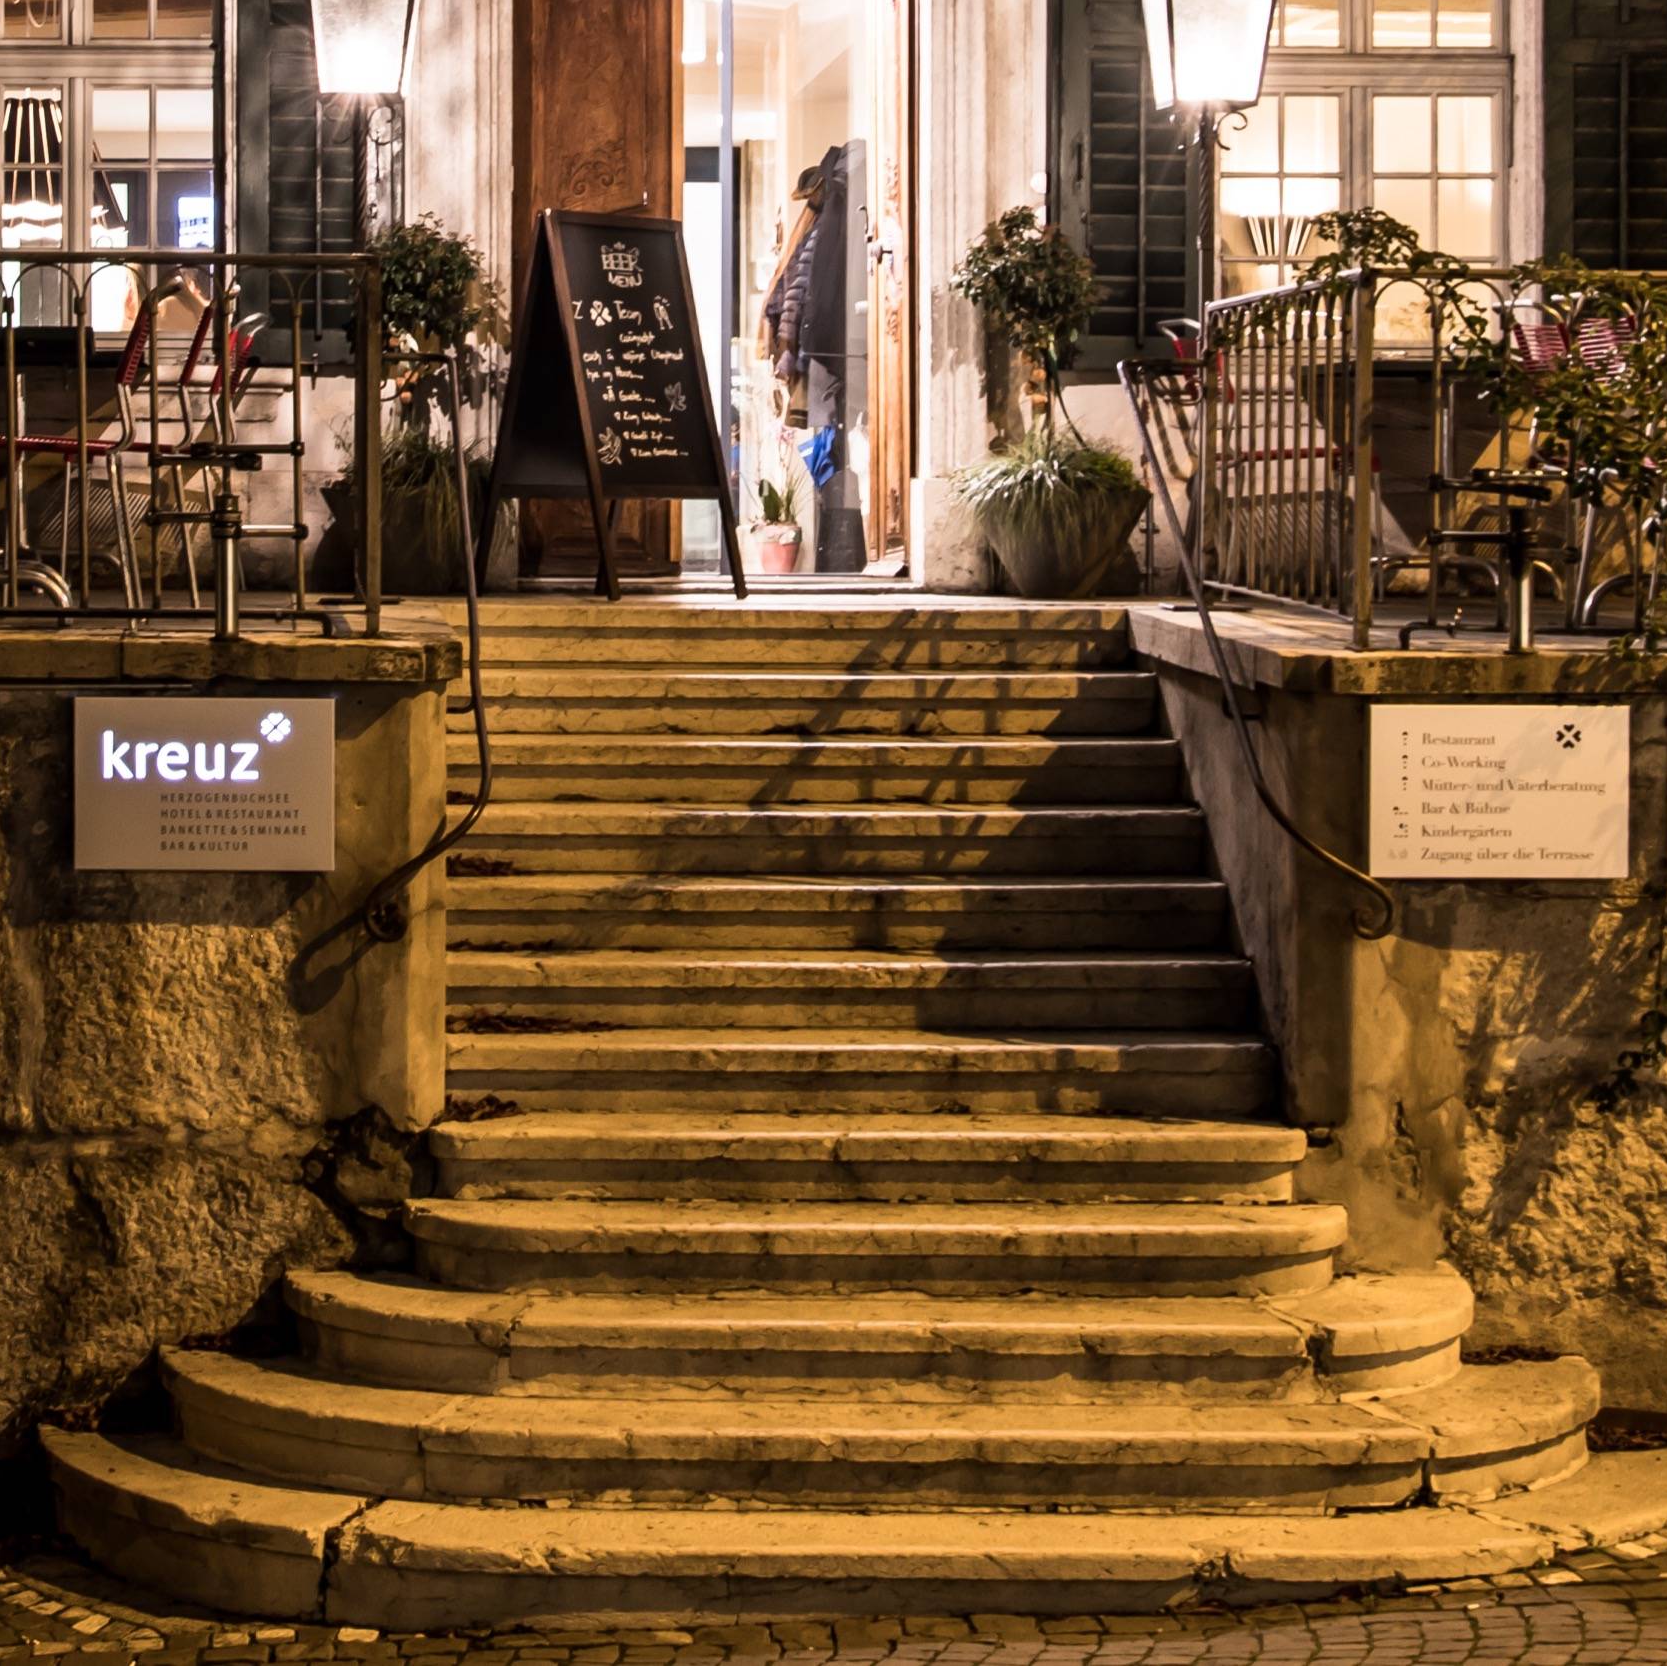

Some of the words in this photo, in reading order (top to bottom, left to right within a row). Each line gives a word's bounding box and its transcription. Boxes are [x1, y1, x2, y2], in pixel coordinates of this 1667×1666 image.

[1421, 733, 1496, 746] Restaurant
[101, 730, 260, 781] kreuz
[1421, 755, 1507, 771] Co-Working
[1476, 779, 1504, 792] und
[1506, 777, 1607, 795] Väterberatung
[160, 793, 290, 804] HERZOGENBUCHSEE
[160, 809, 202, 820] HOTEL
[205, 809, 214, 820] &
[216, 809, 301, 820] RESTAURANT
[1421, 803, 1445, 815] Bar
[1448, 803, 1460, 815] &
[1465, 801, 1511, 815] Bühne
[160, 825, 228, 836] BANKETTE
[230, 825, 238, 836] &
[241, 825, 308, 836] SEMINARE
[1421, 824, 1513, 840] Kindergärten
[160, 841, 186, 852] BAR
[188, 841, 197, 852] &
[199, 841, 249, 852] KULTUR
[1420, 848, 1473, 864] Zugang
[1477, 847, 1509, 861] über
[1512, 847, 1535, 861] die
[1538, 847, 1595, 861] Terrasse
